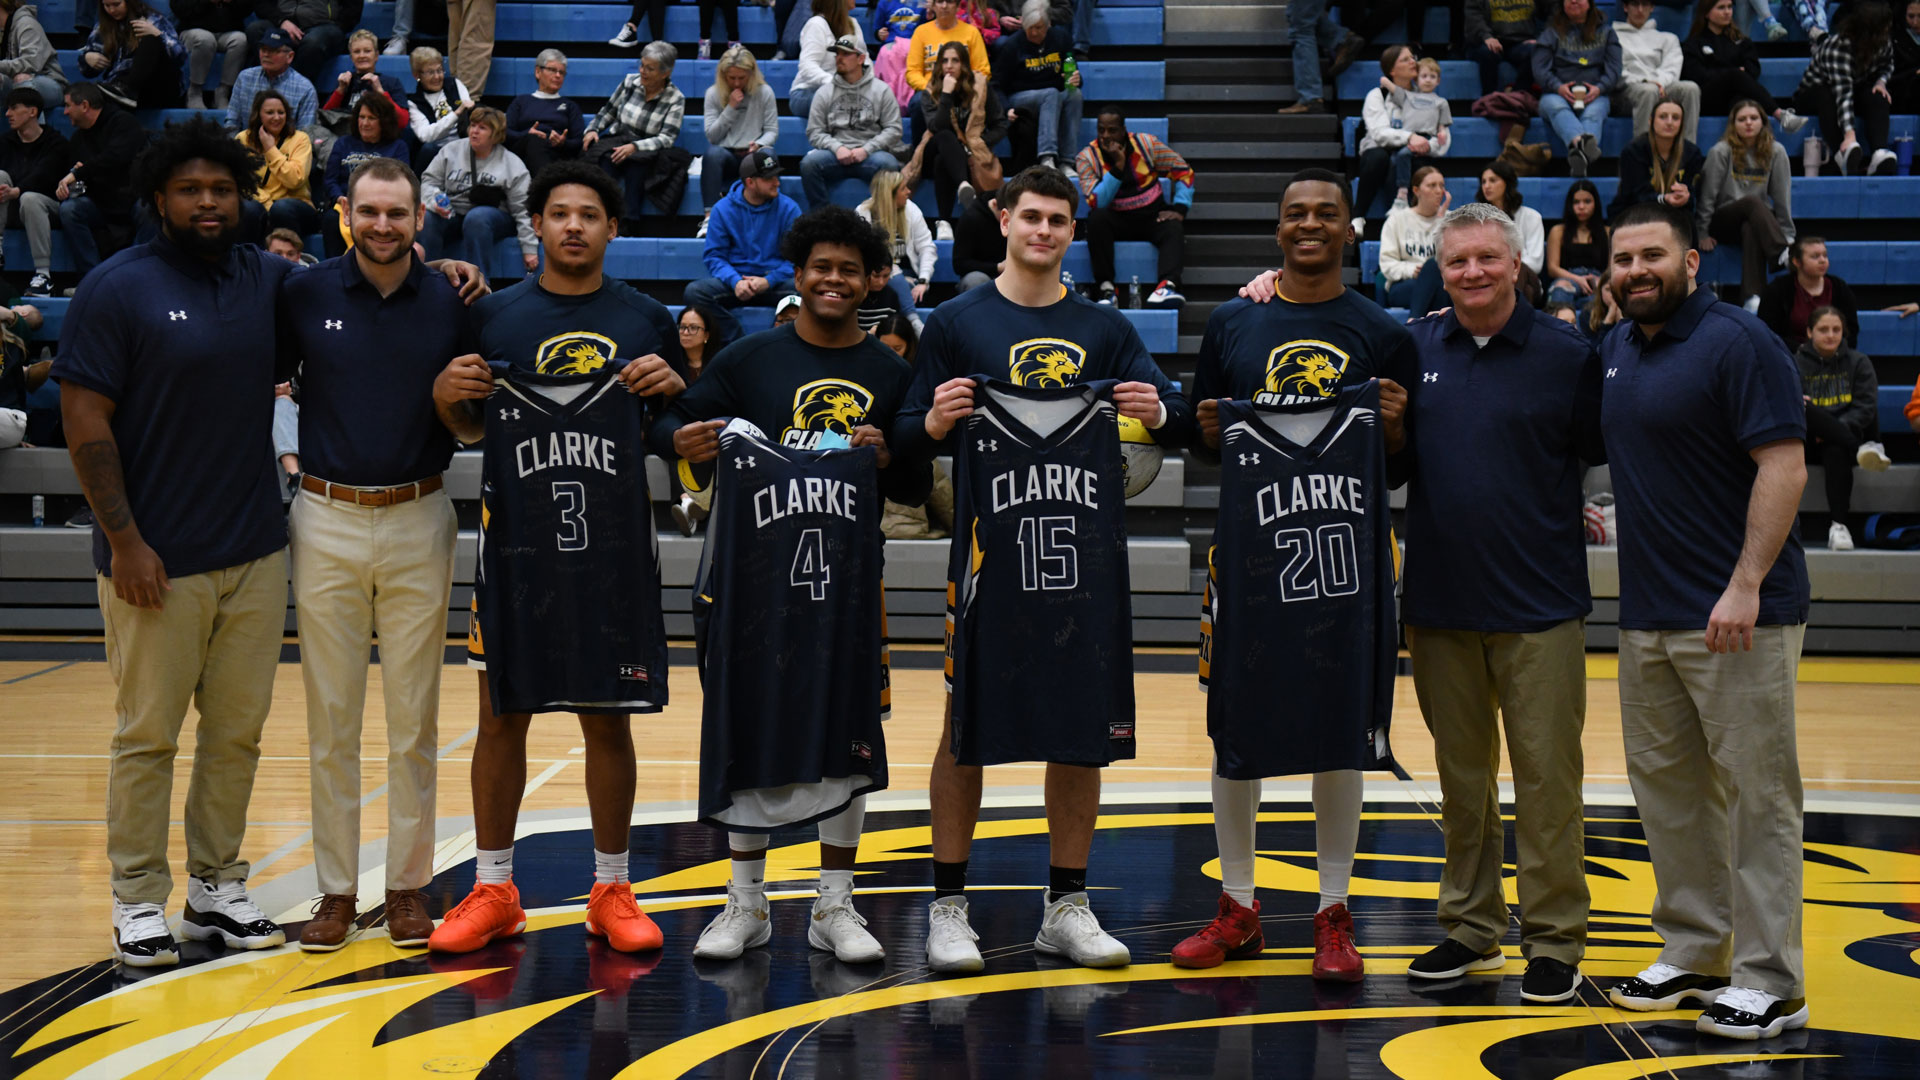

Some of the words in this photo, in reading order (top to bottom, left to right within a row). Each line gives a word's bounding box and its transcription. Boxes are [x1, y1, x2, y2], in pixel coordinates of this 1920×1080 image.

[447, 169, 497, 184] CLAKE
[1255, 392, 1328, 406] CLA
[516, 432, 617, 478] CLARKE
[783, 429, 853, 451] CLA
[754, 477, 857, 528] CLARKE
[992, 464, 1098, 514] CLARKE
[1257, 474, 1364, 527] CLARKE
[552, 481, 588, 551] 3
[790, 529, 830, 600] 4
[1017, 516, 1078, 591] 15
[1275, 523, 1360, 603] 20
